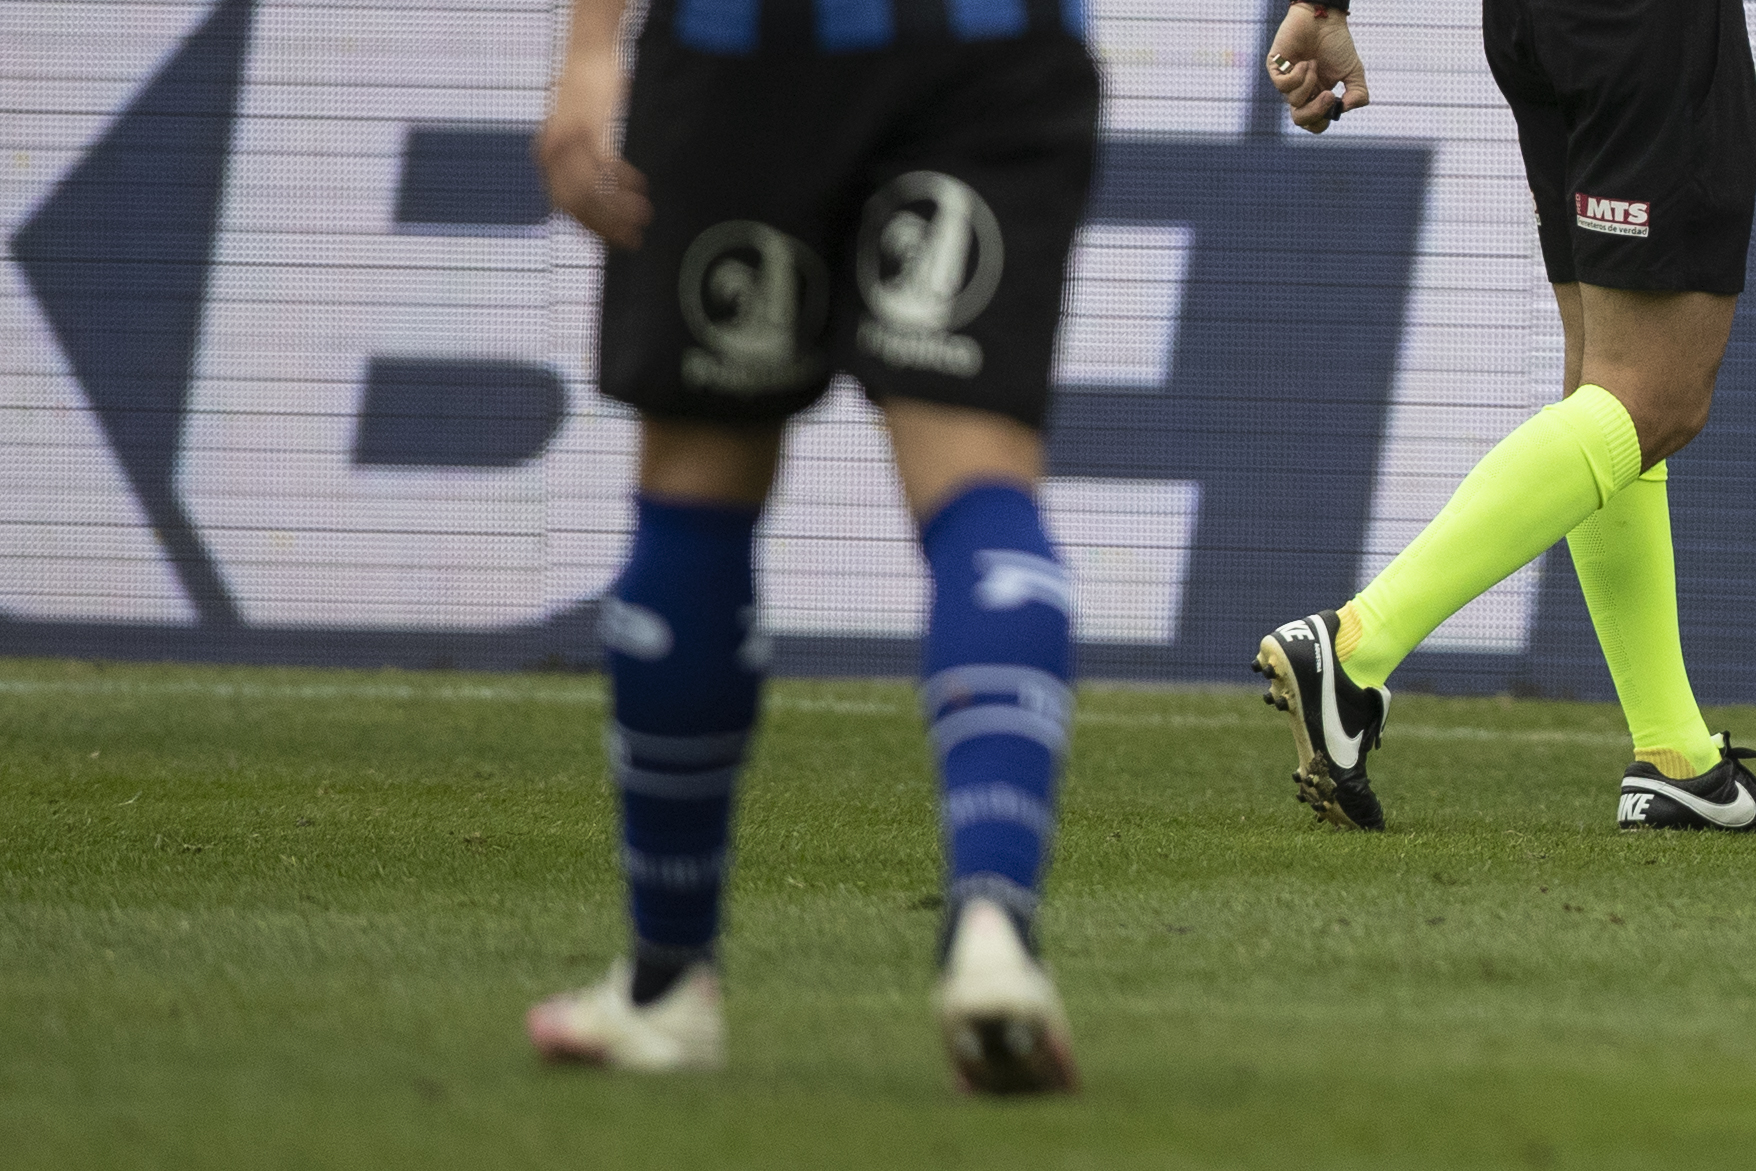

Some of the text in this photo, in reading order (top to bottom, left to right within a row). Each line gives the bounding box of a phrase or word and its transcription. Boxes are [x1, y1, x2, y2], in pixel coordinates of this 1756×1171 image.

[1587, 197, 1648, 223] MTS
[1607, 224, 1617, 232] de
[1619, 226, 1647, 235] verdad
